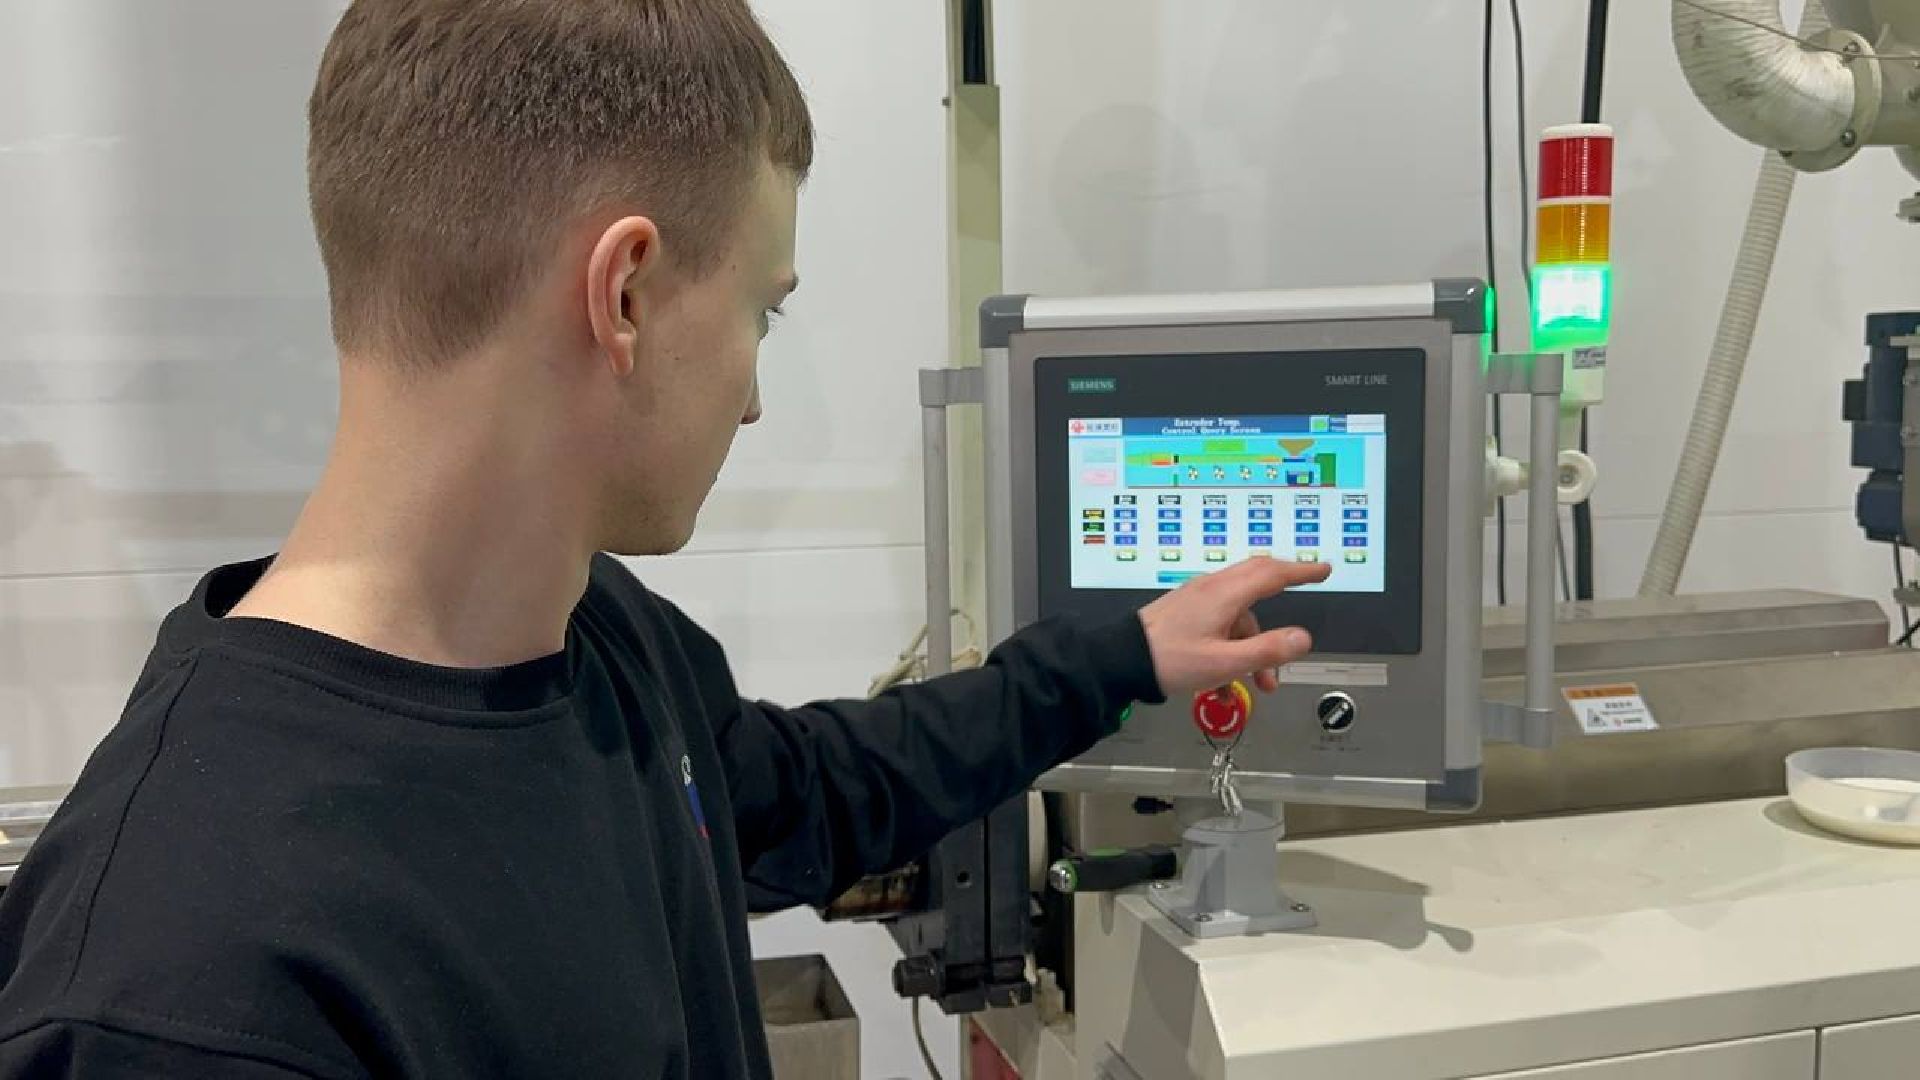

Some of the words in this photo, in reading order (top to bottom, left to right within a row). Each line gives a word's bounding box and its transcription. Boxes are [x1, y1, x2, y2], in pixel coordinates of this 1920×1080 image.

[1325, 374, 1361, 385] SMART
[1364, 374, 1388, 385] LINE
[1070, 380, 1115, 390] SIEMENS
